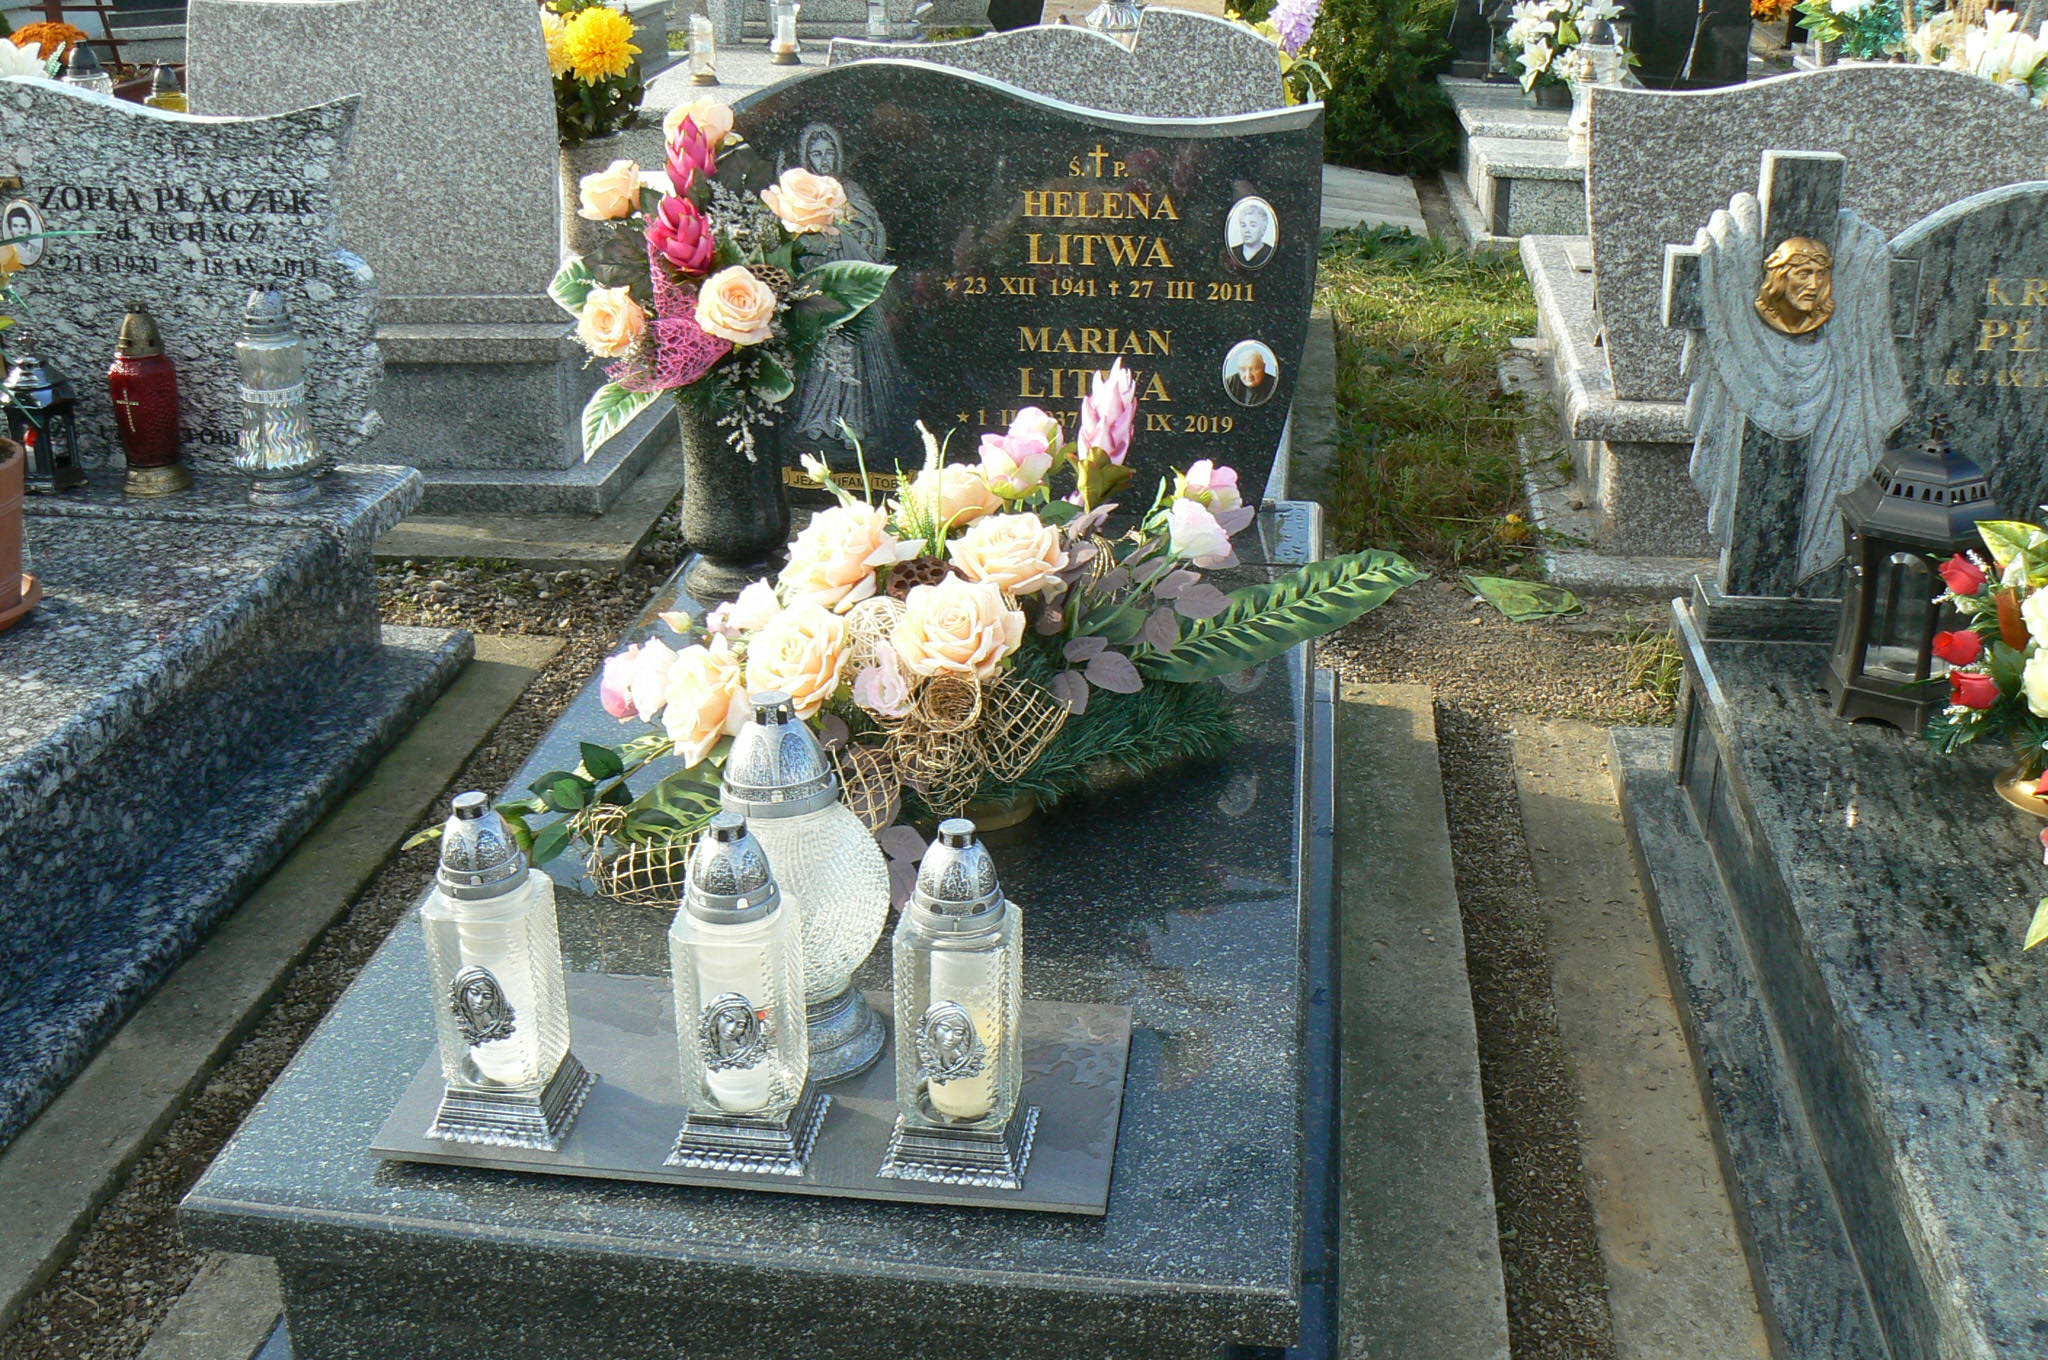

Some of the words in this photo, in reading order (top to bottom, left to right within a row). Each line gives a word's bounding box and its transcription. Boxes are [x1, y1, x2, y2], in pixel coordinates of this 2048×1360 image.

[1113, 161, 1129, 177] P.
[38, 186, 143, 213] ZOFIA
[155, 188, 316, 215] PŁACZEK
[1022, 190, 1181, 220] HELENA
[1025, 233, 1174, 268] LITWA
[964, 277, 988, 295] 23
[1000, 277, 1037, 296] XII
[1050, 279, 1097, 297] 1941
[1129, 280, 1153, 299] 27
[1166, 281, 1196, 300] III
[1207, 282, 1255, 302] 2011
[1018, 326, 1172, 356] MARIAN
[1018, 367, 1172, 402] LITA
[978, 408, 987, 426] 1
[1146, 413, 1173, 433] IX
[1184, 414, 1234, 434] 2019
